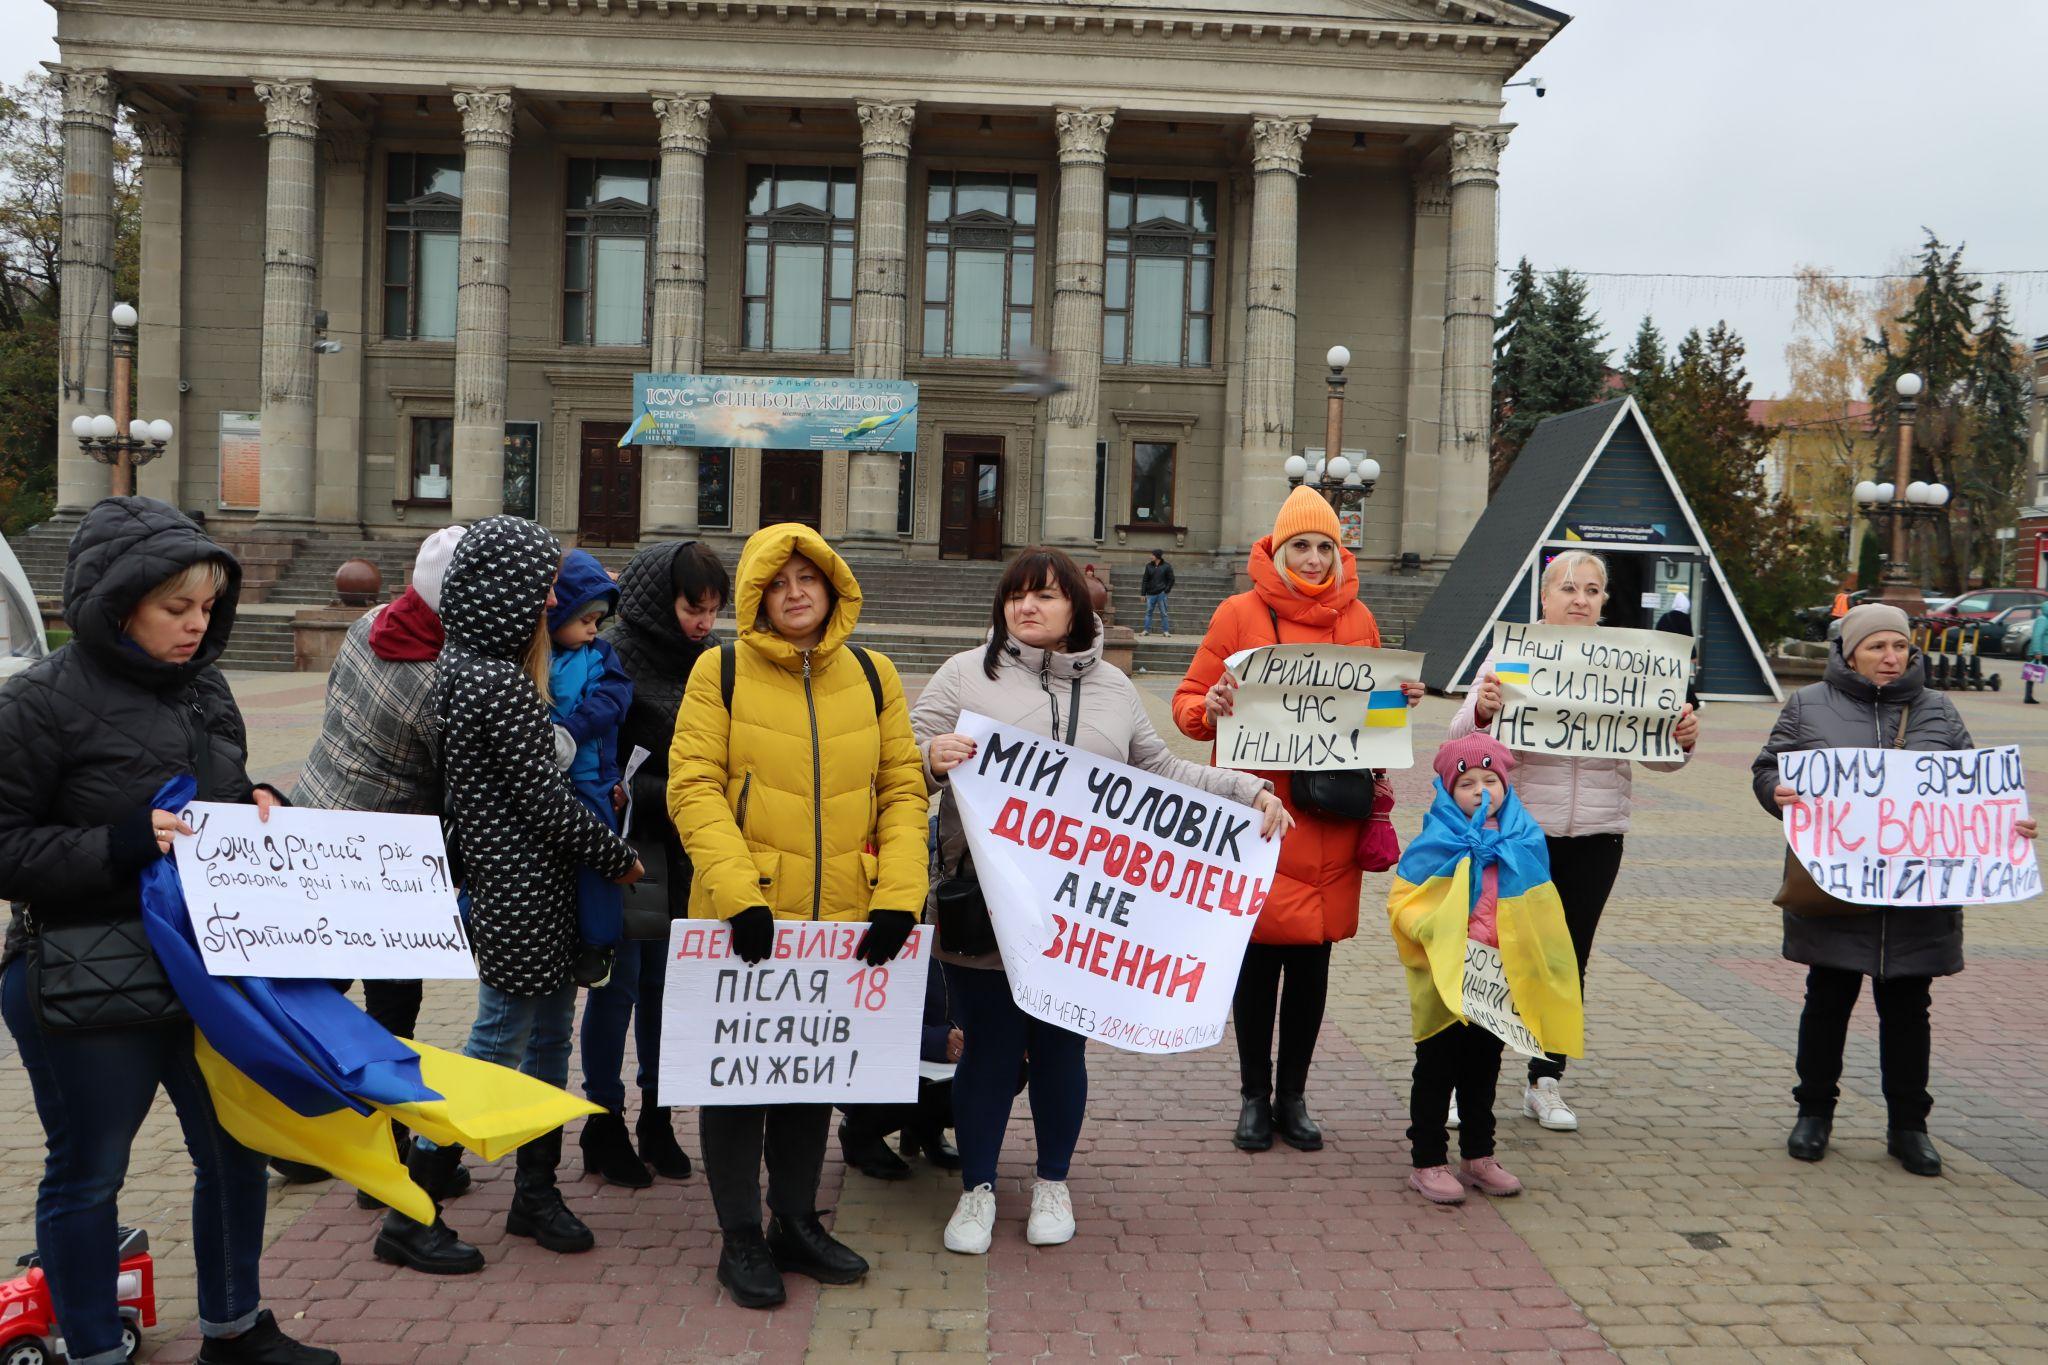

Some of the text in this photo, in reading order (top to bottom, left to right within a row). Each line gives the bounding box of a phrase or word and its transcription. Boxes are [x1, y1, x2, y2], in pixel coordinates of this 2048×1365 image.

[646, 388, 694, 407] ІСУС
[713, 390, 758, 408] СИН
[761, 391, 811, 410] БОГА
[815, 393, 903, 413] ЖИВОГО
[734, 378, 838, 388] ТЕАТРАЛЬНОГО
[849, 381, 901, 390] СЕЗОНУ
[1282, 693, 1337, 723] ЧАС
[1531, 667, 1646, 708] СИЛЬНІ
[1496, 704, 1538, 747] НЕ
[1780, 748, 2025, 798] ЧОМУ ДРУГИЙ
[978, 732, 1251, 863] МІЙ ЧОЛОВІК
[181, 808, 262, 865] Чому
[378, 842, 413, 877] рік
[1789, 796, 2030, 865] РІК ВОЮЮТЬ
[989, 796, 1270, 917] ДОБРОВОЛЕЦЬ
[299, 875, 332, 900] одні
[1053, 871, 1137, 928] А НЕ
[1808, 856, 1887, 899] ОДНІ
[1892, 859, 1926, 902] Й
[1928, 858, 1979, 899] ТІ
[335, 928, 376, 947] час
[1464, 944, 1509, 983] ХОЧ
[715, 963, 889, 1011] ПІСЛЯ 18
[714, 1009, 850, 1047] МІСЯЦІВ
[1054, 998, 1096, 1033] ЧЕРЕЗ
[1099, 1016, 1121, 1038] 18
[1118, 1022, 1183, 1049] МІСЯЦІВ
